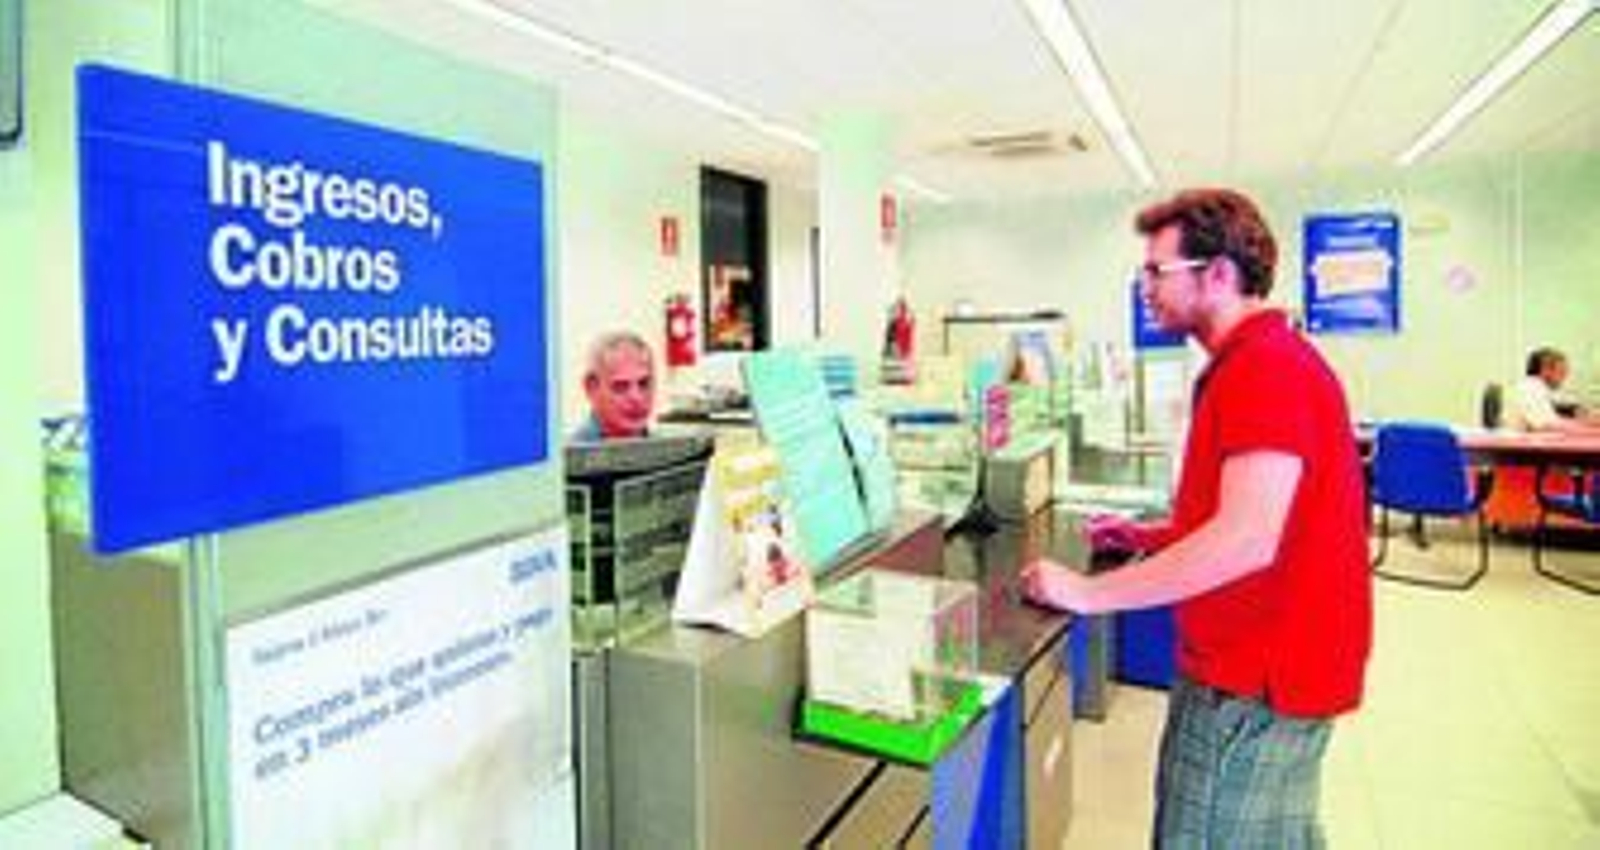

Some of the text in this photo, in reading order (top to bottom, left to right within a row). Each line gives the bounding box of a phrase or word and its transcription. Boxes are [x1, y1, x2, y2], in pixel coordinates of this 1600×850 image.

[207, 140, 443, 240] Ingresos,
[209, 222, 400, 291] Cobros
[211, 303, 493, 382] y Consultas
